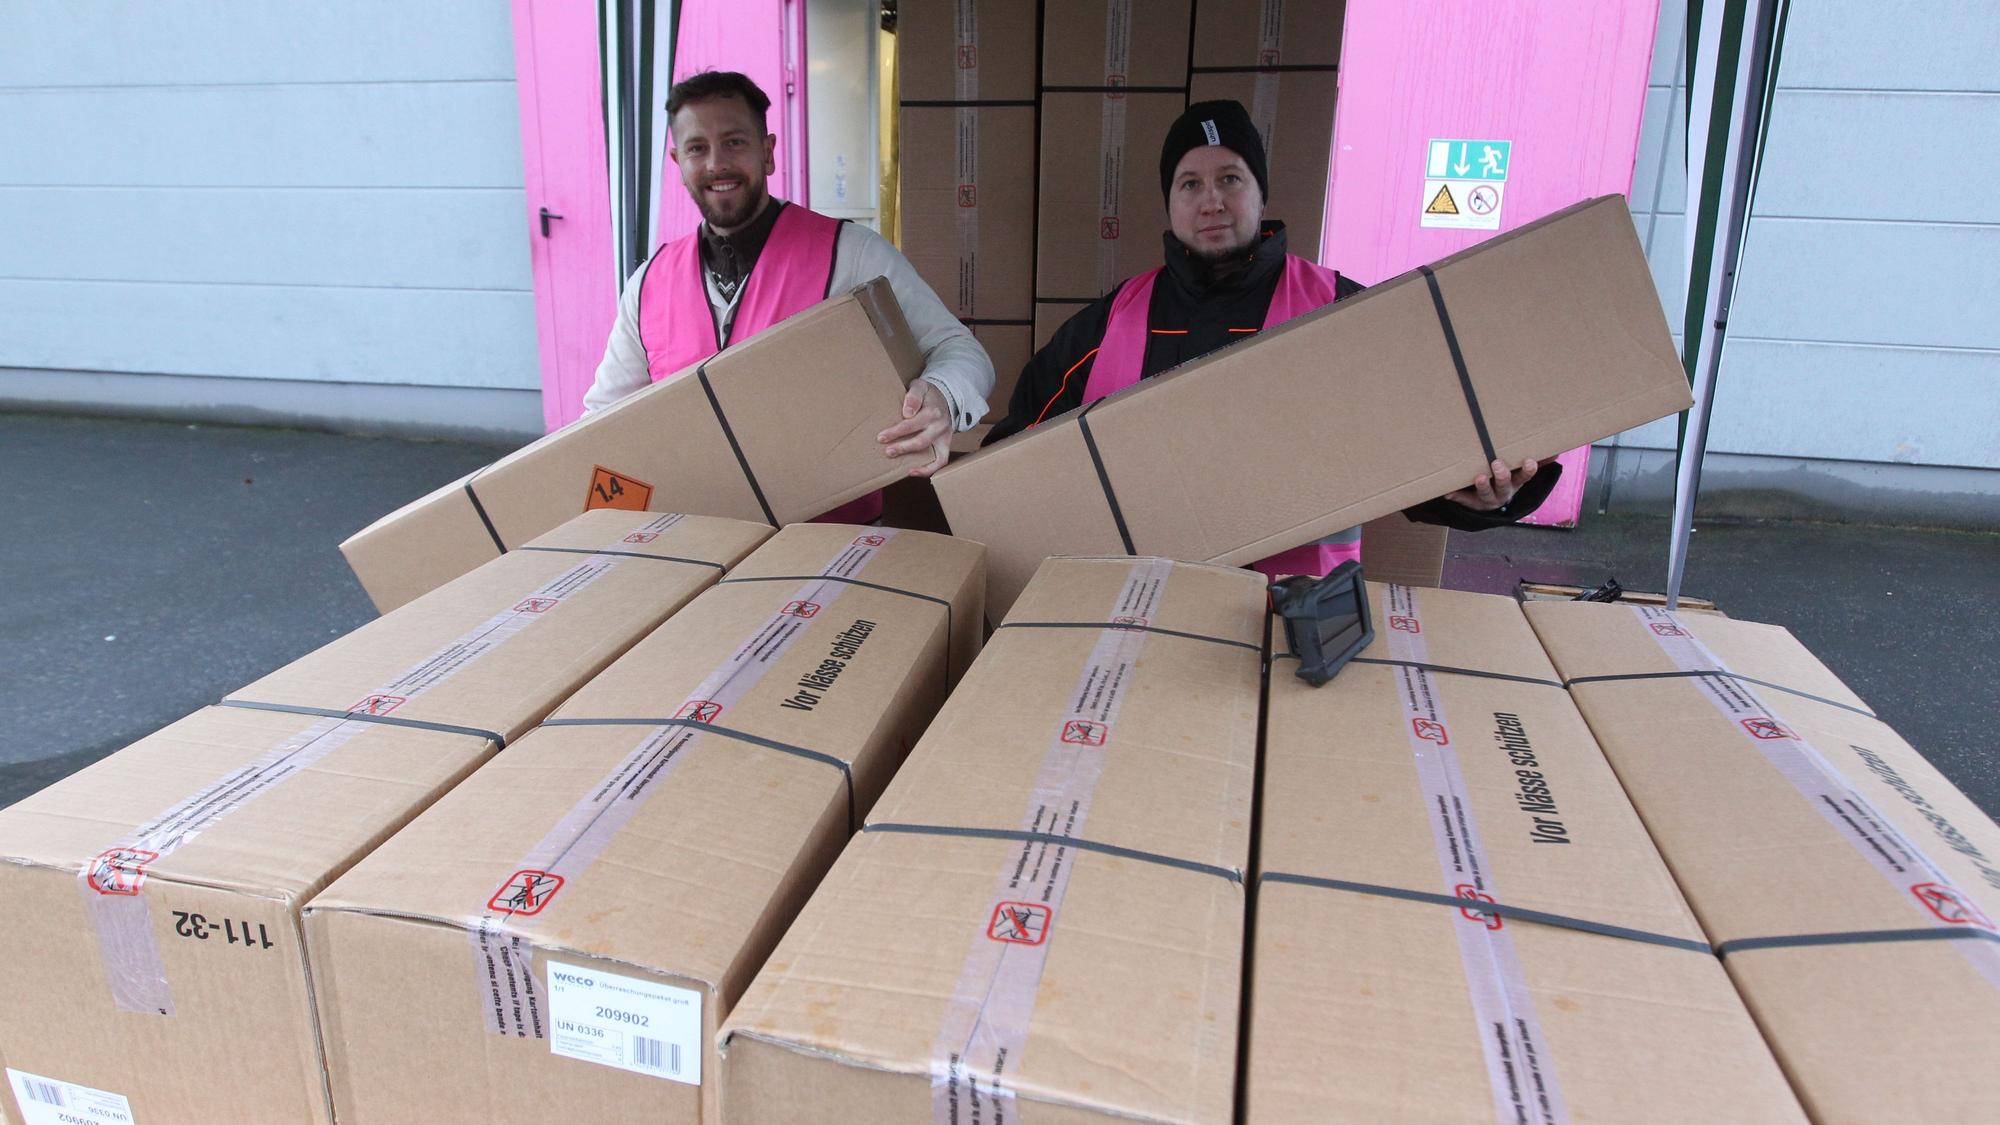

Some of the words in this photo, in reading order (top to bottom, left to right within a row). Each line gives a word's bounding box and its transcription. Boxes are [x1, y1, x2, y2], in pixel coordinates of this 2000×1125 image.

[594, 476, 624, 502] 1.4
[830, 619, 877, 660] schützen
[797, 659, 846, 692] Nässe
[780, 690, 821, 711] Vor
[1493, 712, 1539, 767] schützen
[1515, 769, 1559, 814] Nässe
[1530, 816, 1570, 844] Vor
[172, 910, 274, 949] 111-32
[554, 971, 594, 987] weco
[513, 1007, 522, 1022] tape
[595, 1005, 650, 1028] 209902
[557, 1020, 574, 1032] UN
[577, 1024, 605, 1039] 0336
